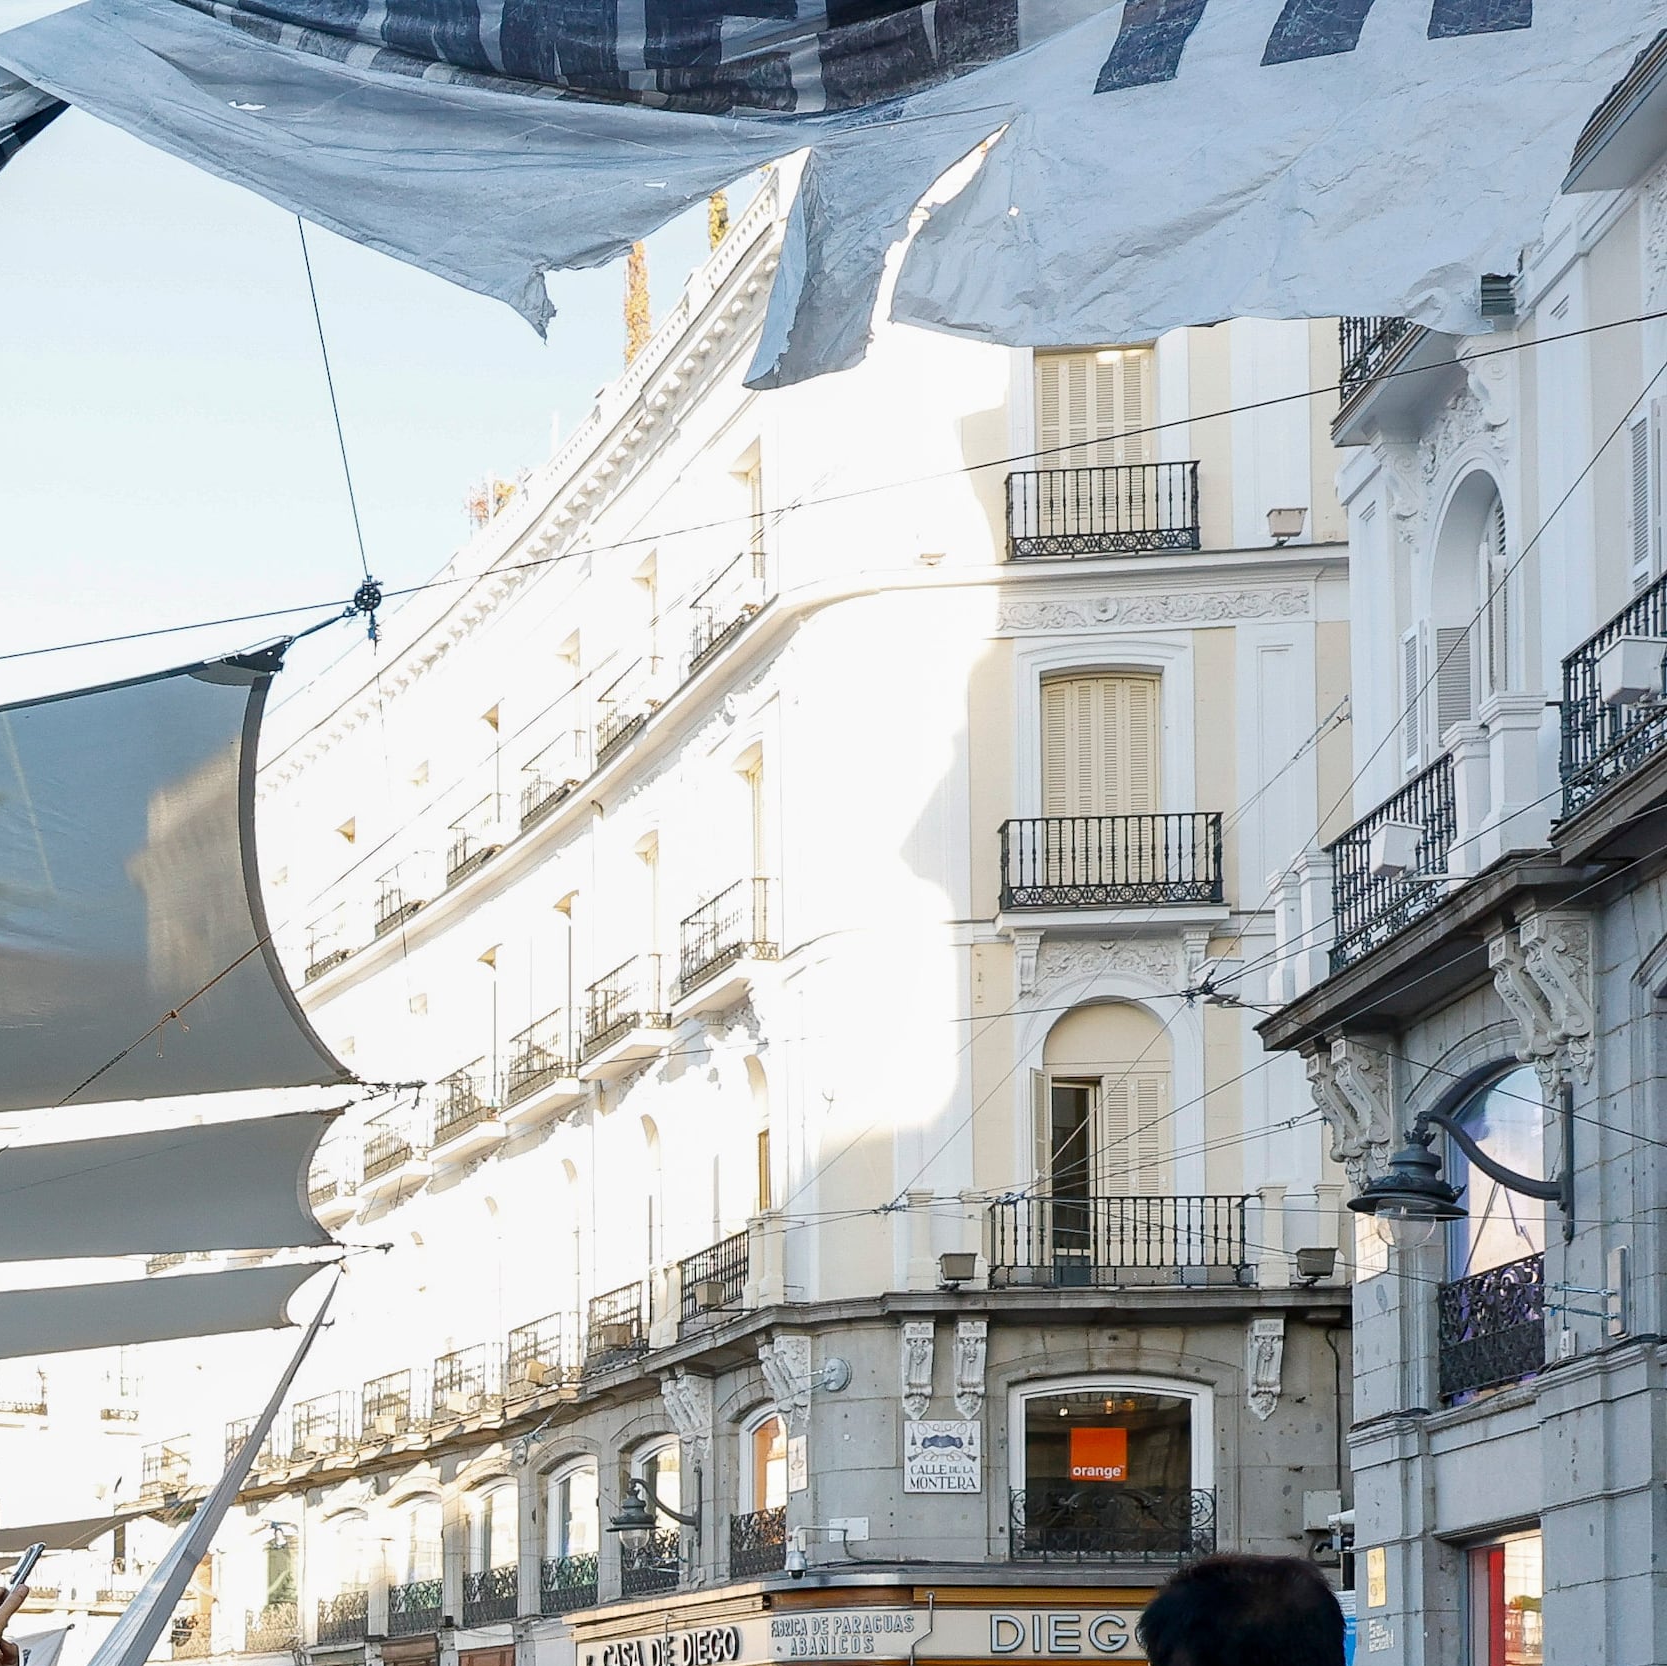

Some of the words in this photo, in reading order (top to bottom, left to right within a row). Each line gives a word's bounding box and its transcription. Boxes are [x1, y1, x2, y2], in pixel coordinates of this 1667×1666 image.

[910, 1465, 947, 1475] CALLE
[1072, 1465, 1122, 1479] orange
[909, 1476, 977, 1490] MONTERA
[811, 1616, 829, 1635] DE
[833, 1614, 916, 1634] PARAGUAS
[990, 1614, 1143, 1653] DIEG
[682, 1625, 741, 1666] DIEGO
[790, 1635, 875, 1656] ABANICOS
